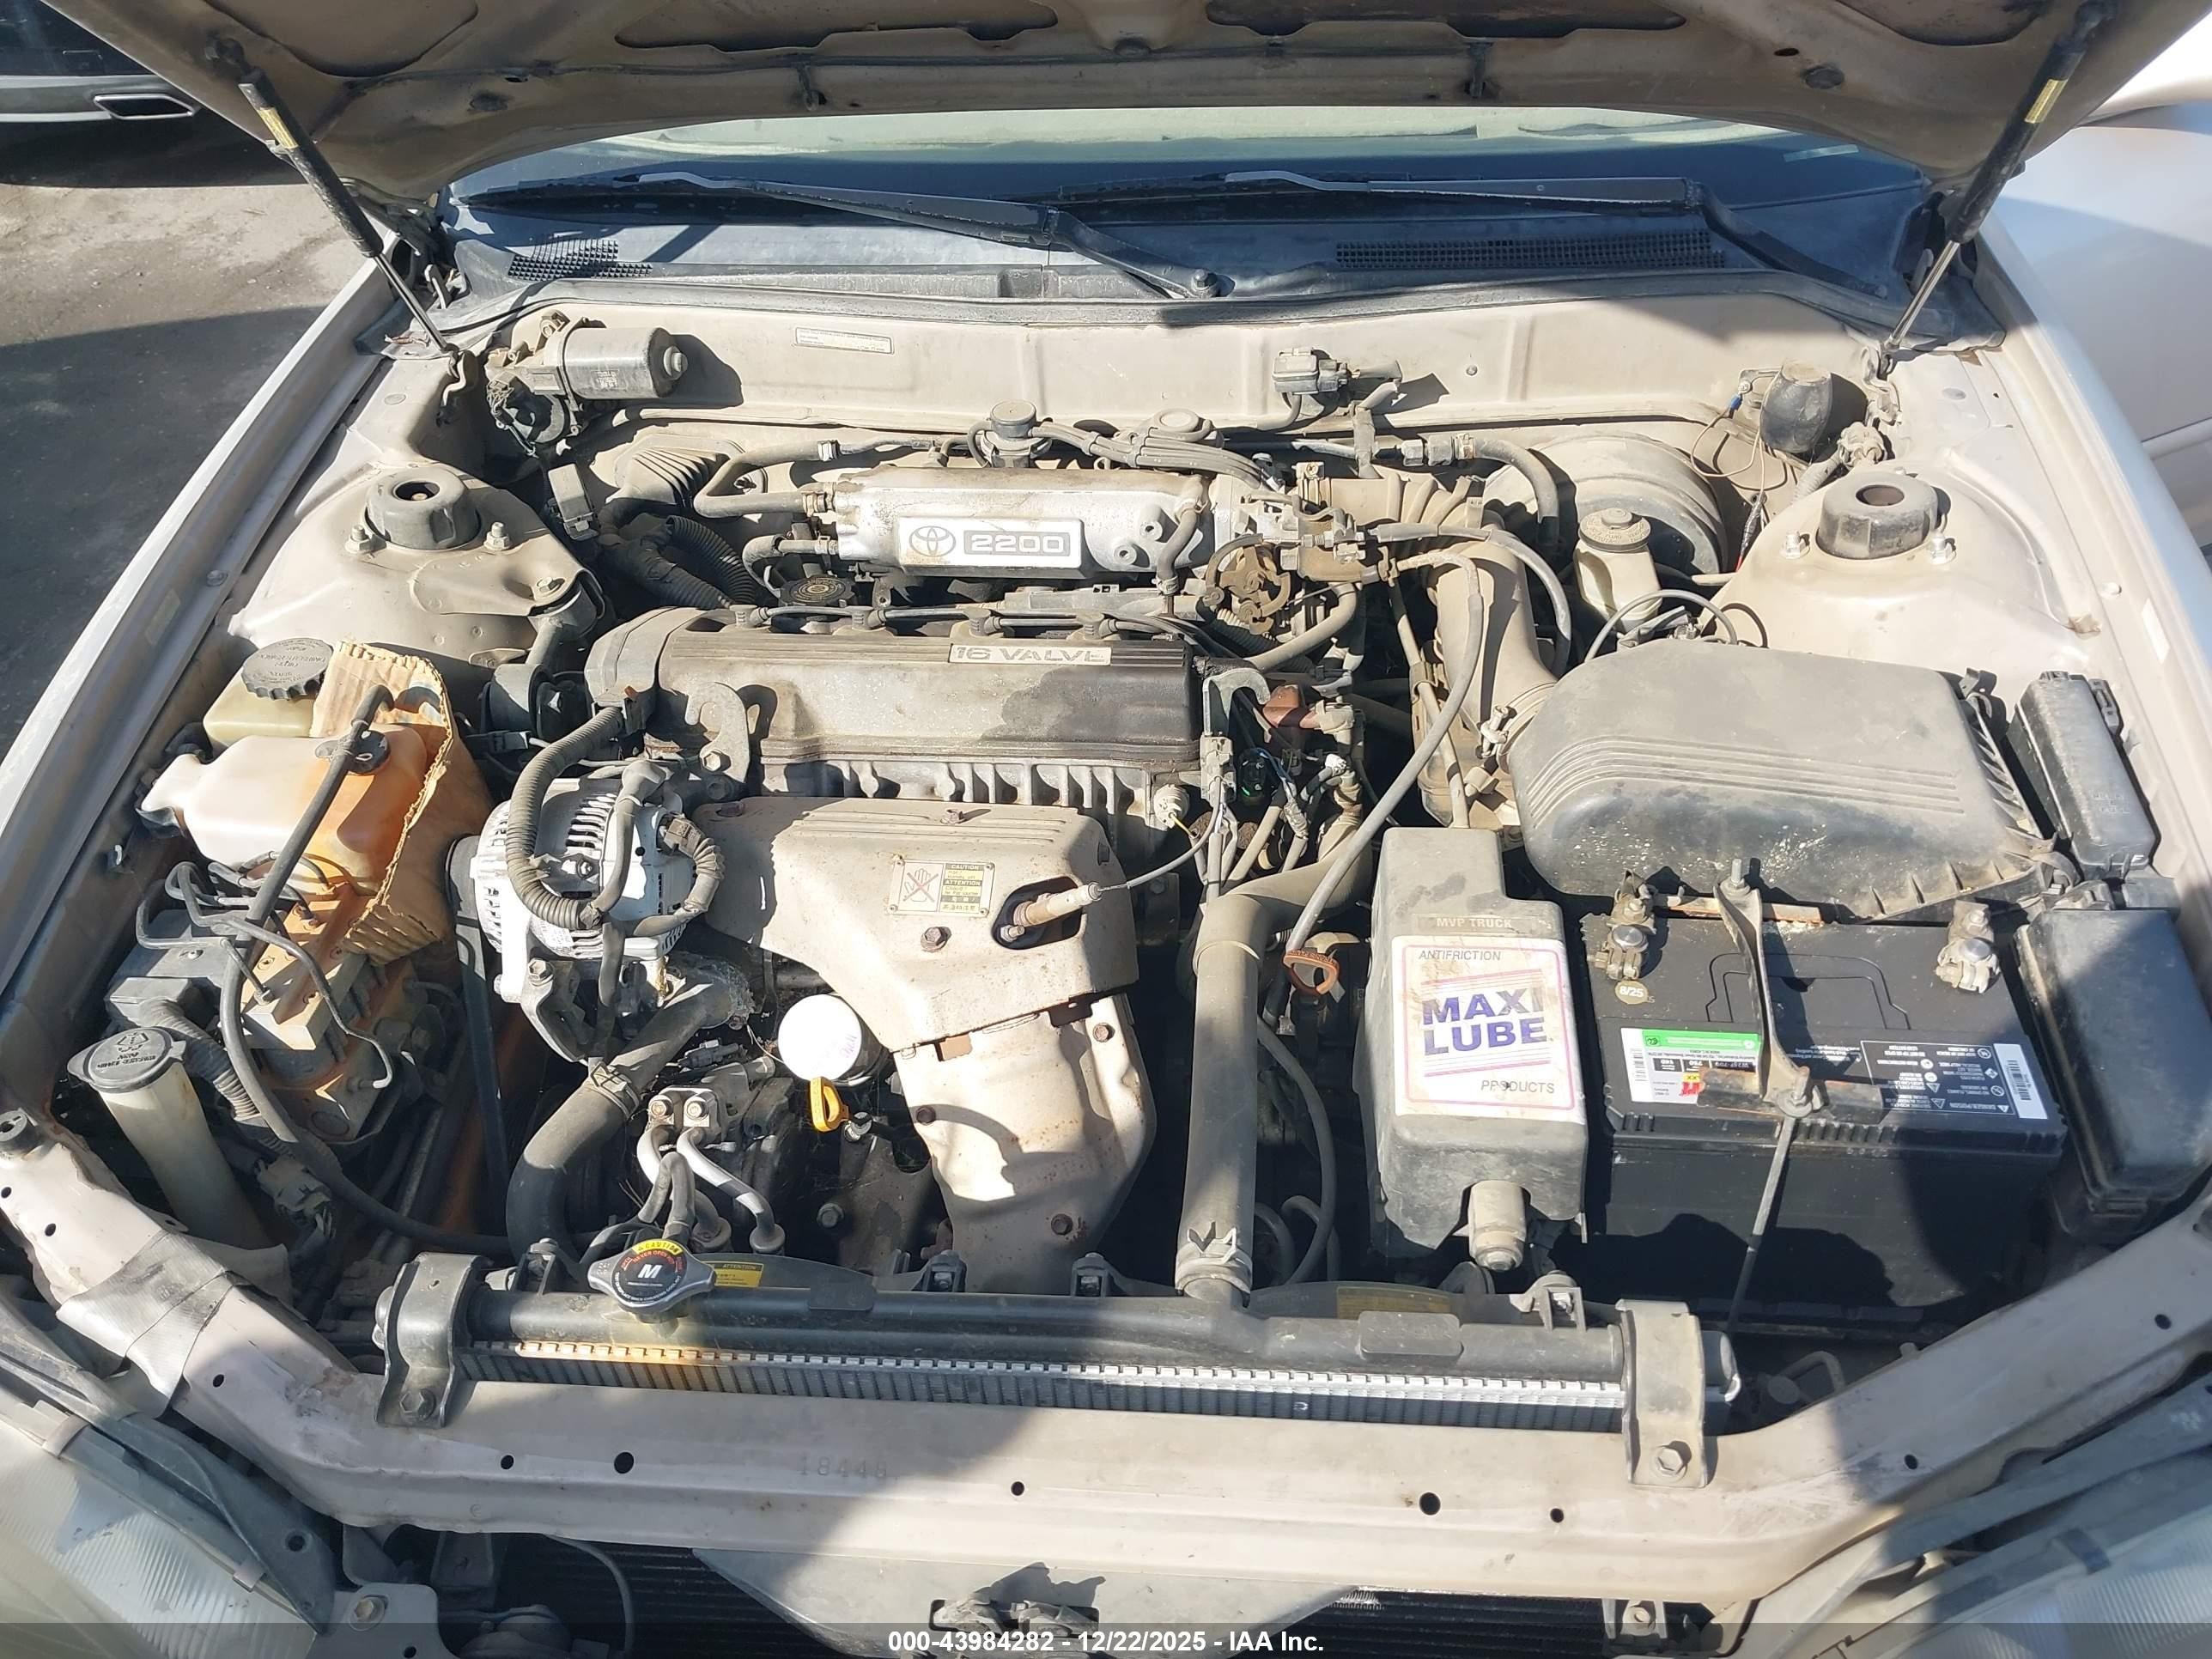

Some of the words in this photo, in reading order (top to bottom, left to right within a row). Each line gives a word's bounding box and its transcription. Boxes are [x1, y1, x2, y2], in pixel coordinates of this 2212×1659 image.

[970, 533, 1064, 554] 2200
[956, 646, 993, 660] 16
[1437, 917, 1465, 927] MVP
[1469, 918, 1513, 929] TRUCK
[1418, 950, 1502, 962] ANTIFRICTION
[1620, 985, 1644, 998] 8/25
[1421, 988, 1544, 1026] MAXI
[1424, 1016, 1547, 1056] LUBE
[645, 1241, 680, 1254] CAUTION
[638, 1263, 663, 1279] M
